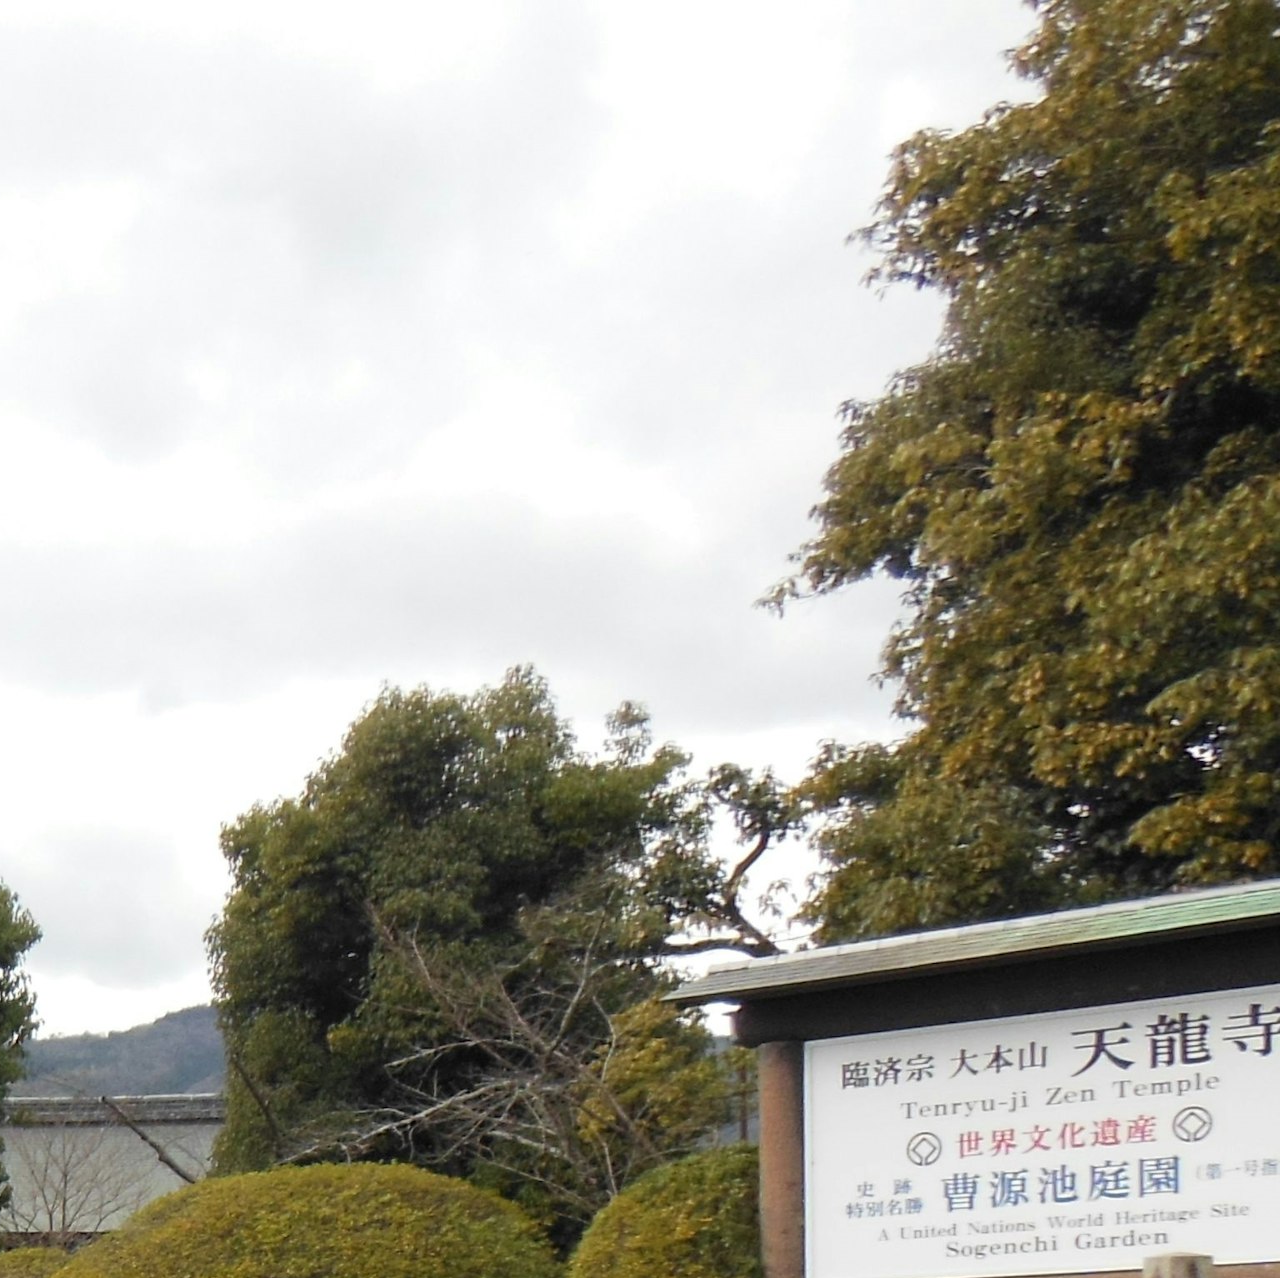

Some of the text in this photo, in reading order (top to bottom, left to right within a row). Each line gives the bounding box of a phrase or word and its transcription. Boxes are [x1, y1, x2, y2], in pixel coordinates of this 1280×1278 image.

[841, 1003, 1280, 1090] 臨済宗 大本山 天龍寺
[900, 1072, 1221, 1120] Tenryu-ji Zen Temple
[957, 1114, 1158, 1160] 世界文化遺産
[941, 1155, 1180, 1213] 曹源池庭園
[845, 1197, 924, 1220] 特別名勝
[878, 1202, 1251, 1242] A United Nations World Heritage Site
[945, 1229, 1170, 1260] Sogenchi Garden
